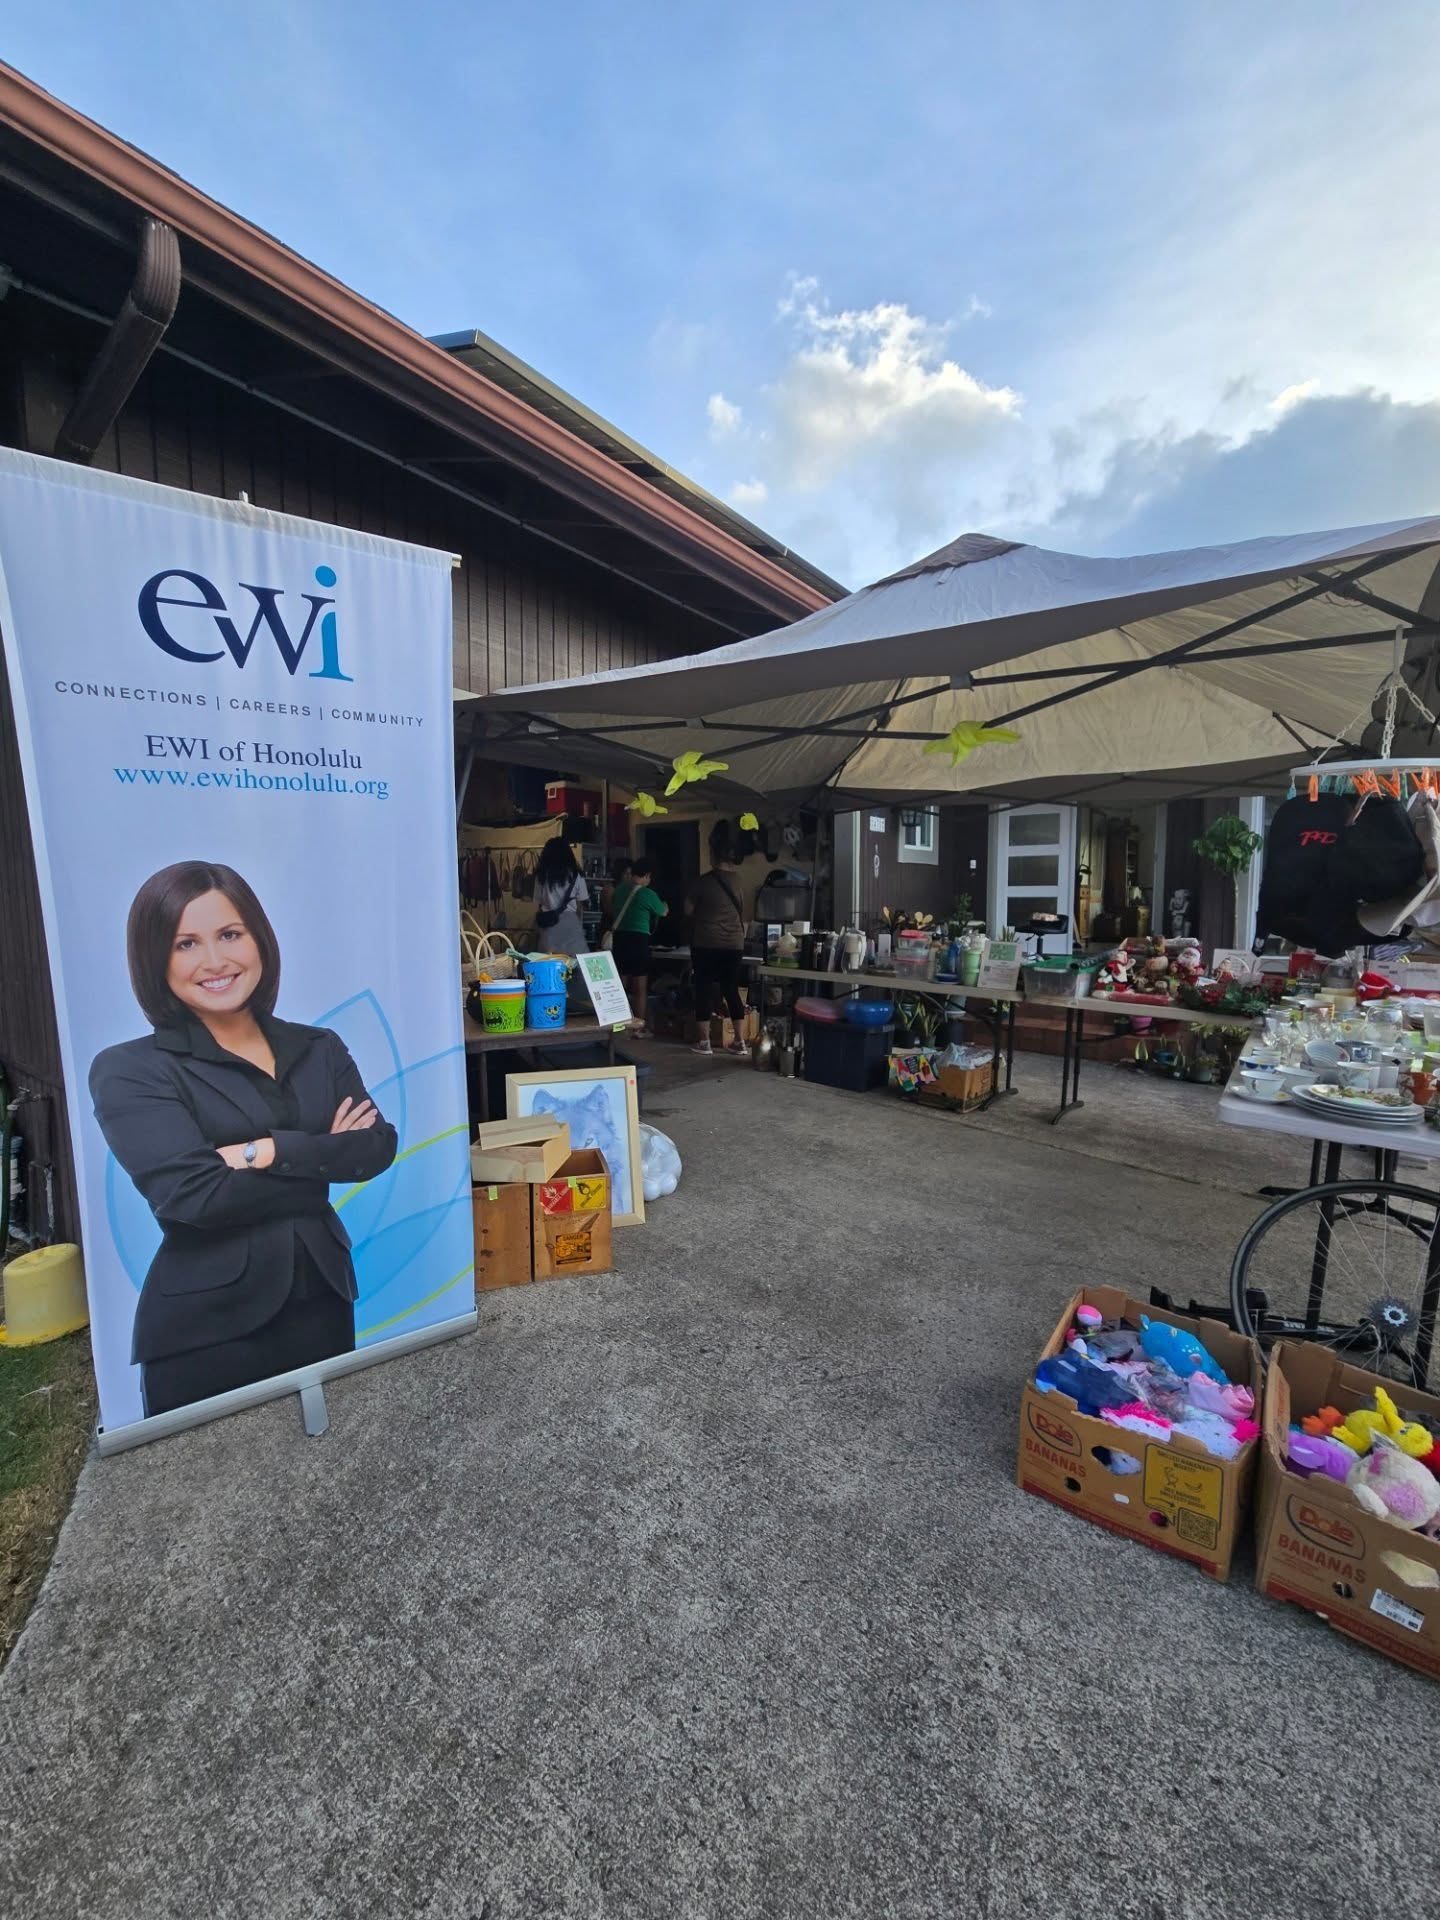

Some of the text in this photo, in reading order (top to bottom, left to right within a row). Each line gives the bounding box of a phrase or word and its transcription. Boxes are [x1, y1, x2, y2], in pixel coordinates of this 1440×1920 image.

[138, 565, 354, 682] ewi
[55, 680, 207, 706] CONNECTIONS
[229, 698, 311, 717] CAREERS
[331, 709, 424, 728] COMMUNITY
[144, 734, 363, 769] EWI of Honolulu
[113, 766, 389, 800] www.ewihonolulu.org
[1036, 1412, 1074, 1441] Dole
[1025, 1438, 1087, 1479] BANANAS
[1300, 1505, 1354, 1543] Dole
[1278, 1533, 1367, 1585] BANANAS
